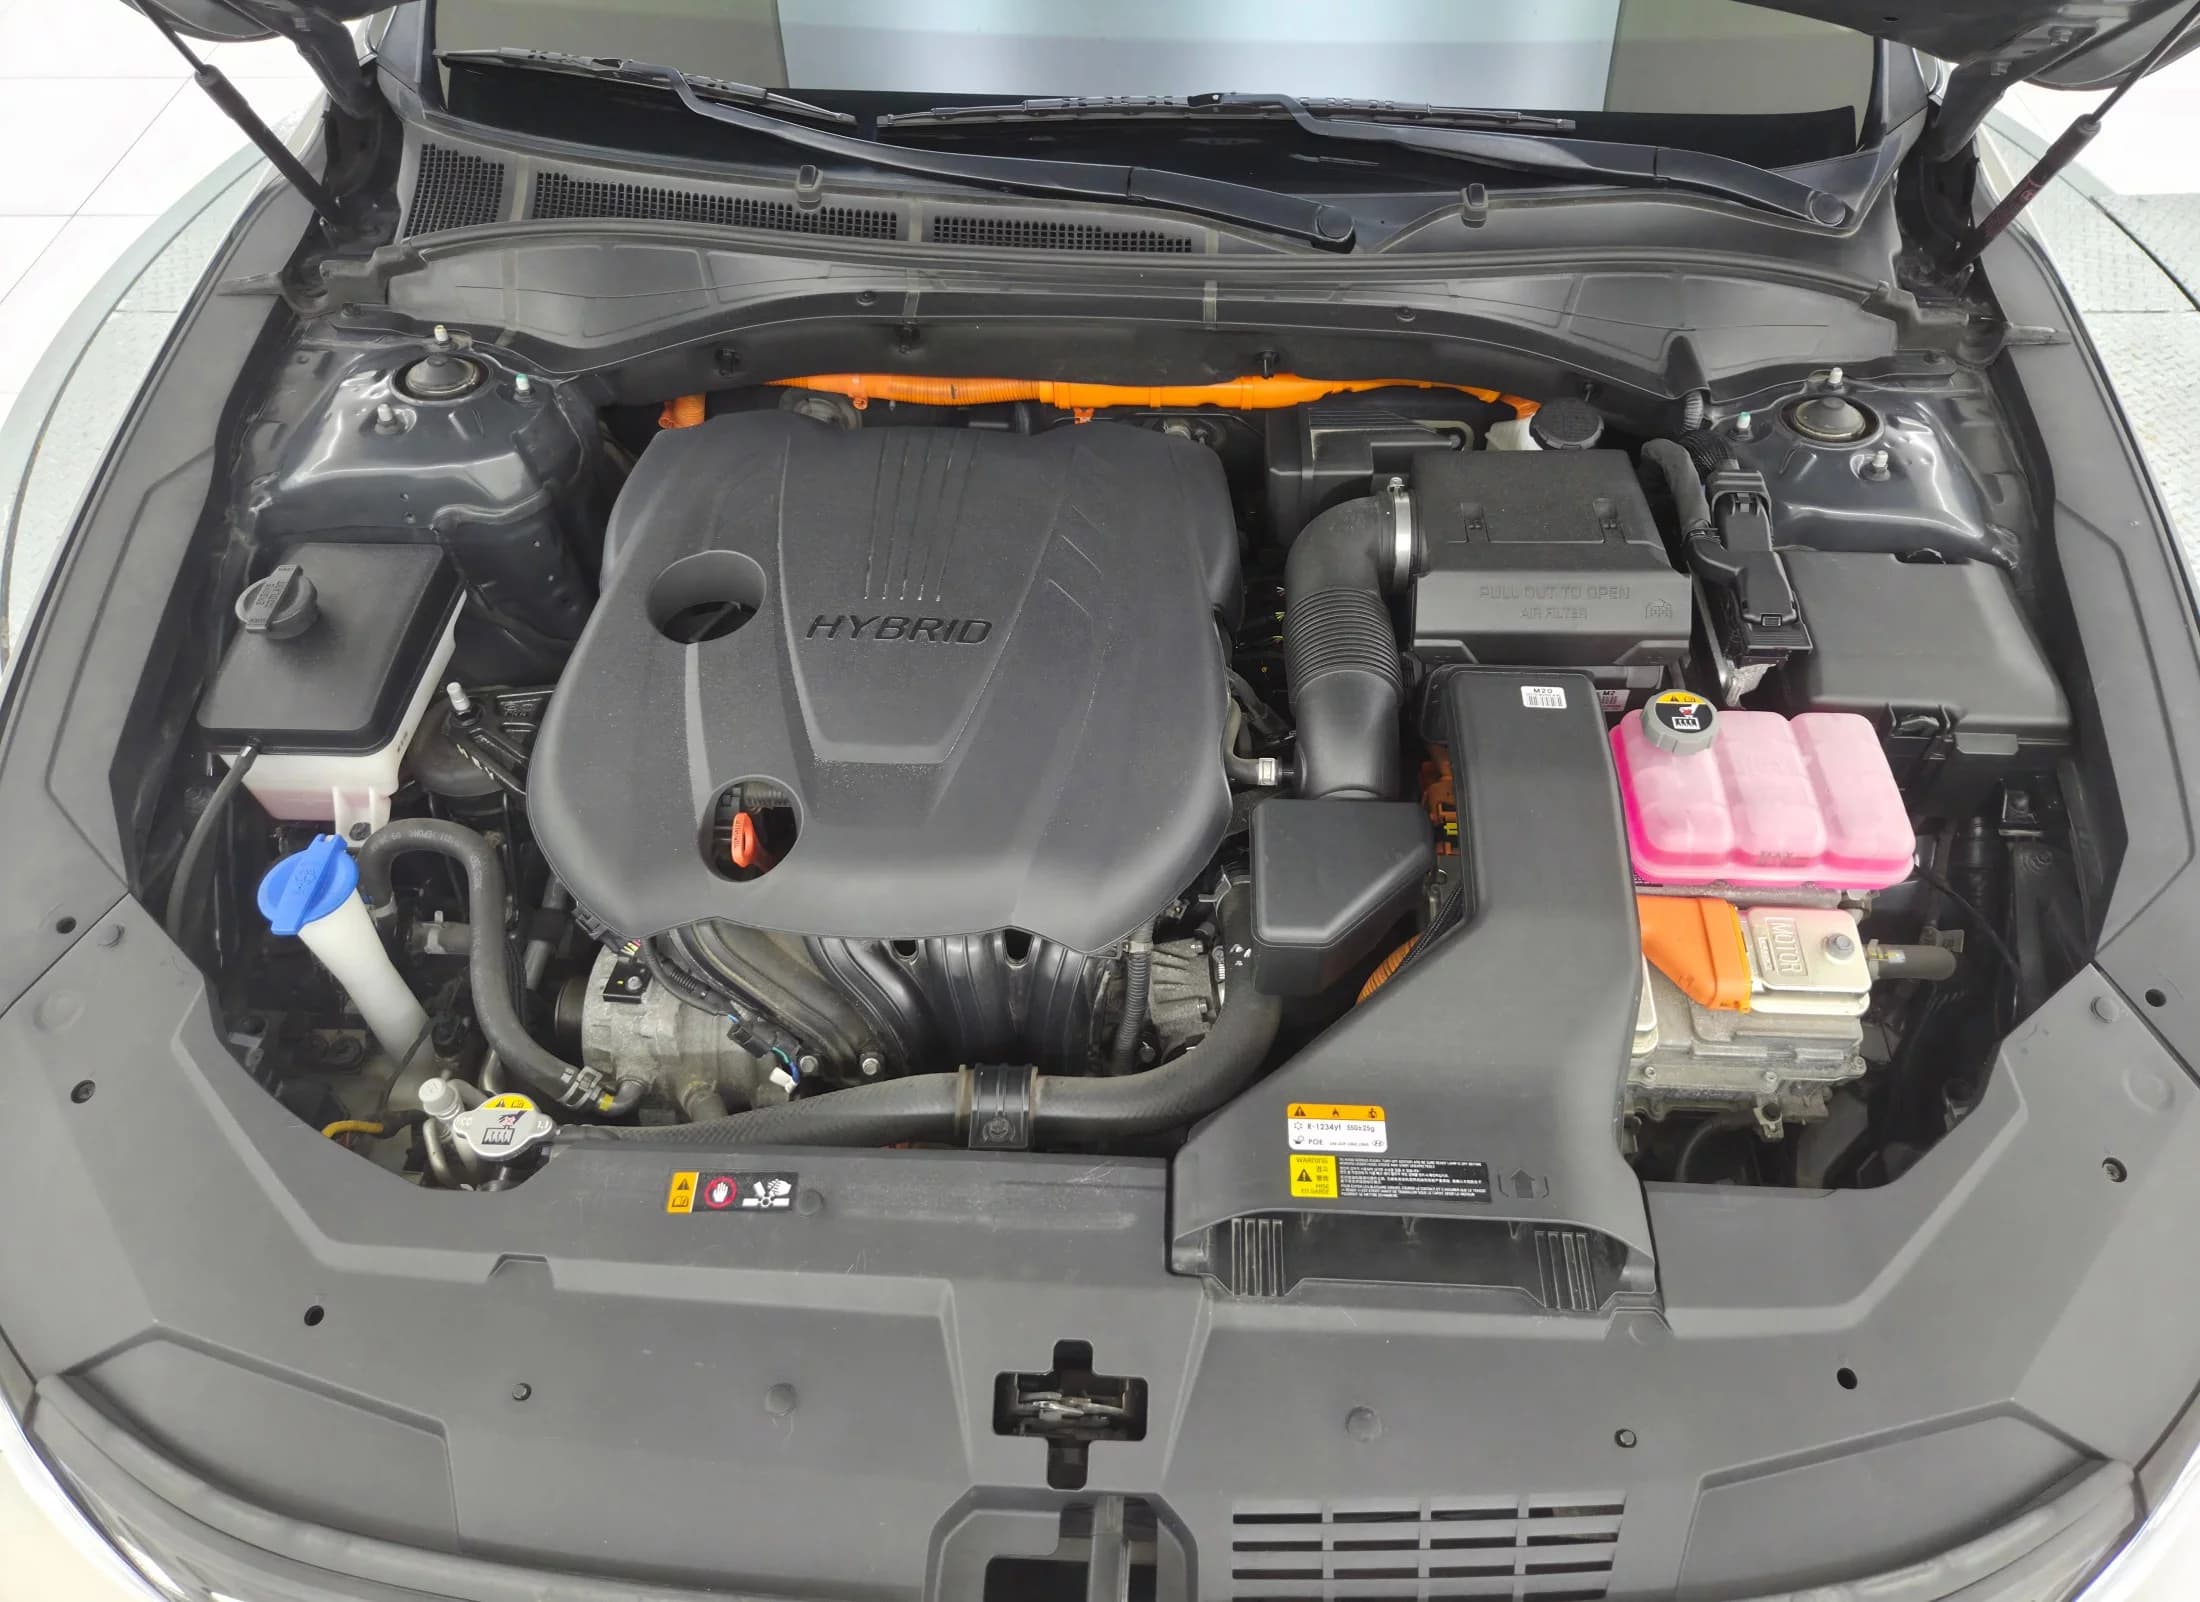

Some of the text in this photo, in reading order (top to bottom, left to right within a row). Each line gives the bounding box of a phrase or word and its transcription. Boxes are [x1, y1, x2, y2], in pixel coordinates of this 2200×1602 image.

[1479, 585, 1631, 600] PULL OUT TO OPEN
[1520, 607, 1588, 620] AIR FILTER
[805, 614, 993, 645] HYBRID
[1770, 922, 1803, 972] MOTOR
